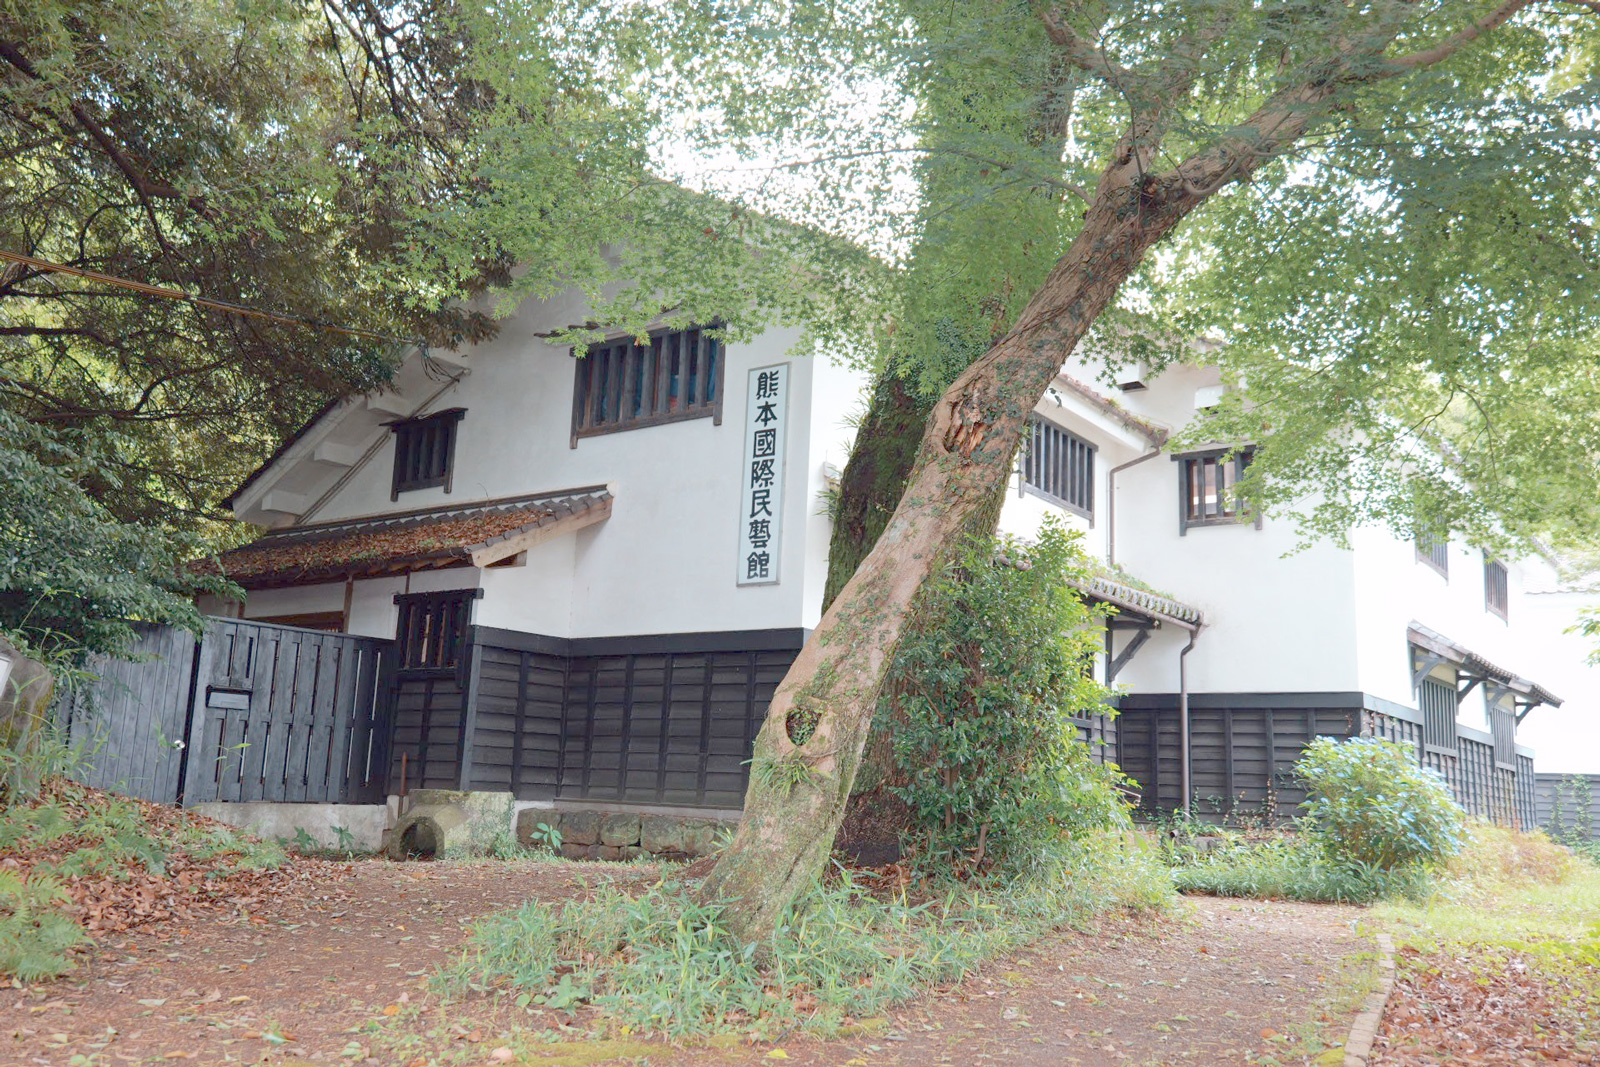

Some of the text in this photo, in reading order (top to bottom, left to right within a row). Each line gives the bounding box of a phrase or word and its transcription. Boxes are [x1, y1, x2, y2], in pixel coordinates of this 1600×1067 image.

[747, 370, 779, 579] 熊本國際民藝館
